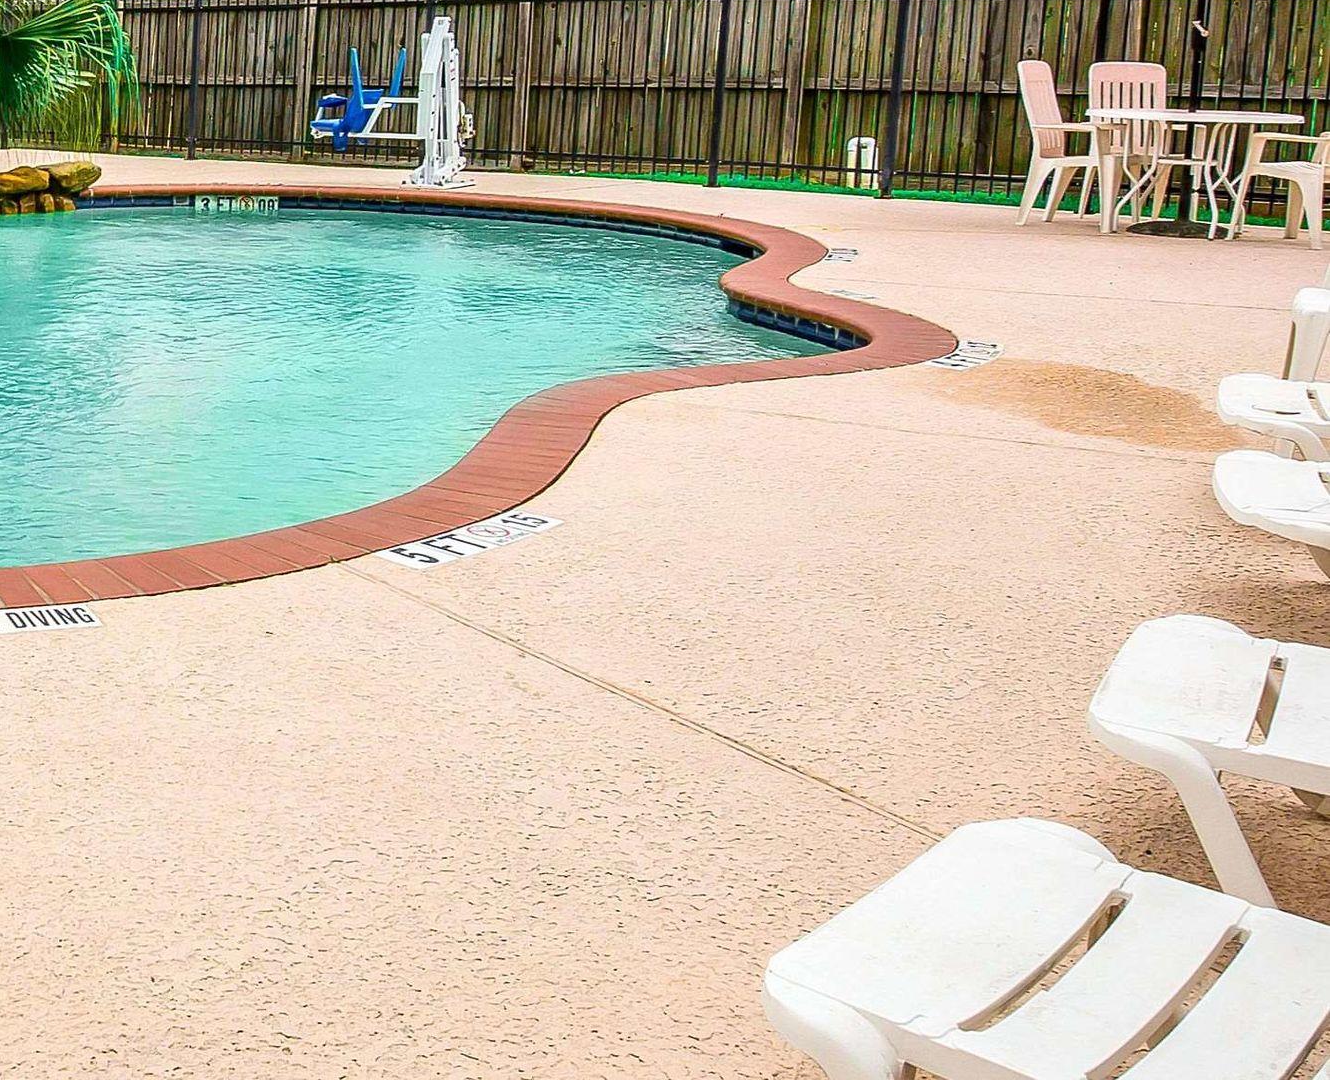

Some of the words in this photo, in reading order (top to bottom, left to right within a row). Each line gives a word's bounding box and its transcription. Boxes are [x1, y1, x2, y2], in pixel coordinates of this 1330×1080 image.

[217, 196, 236, 212] FT
[390, 547, 440, 564] 5
[421, 533, 487, 556] FT
[5, 607, 95, 629] DIVING
